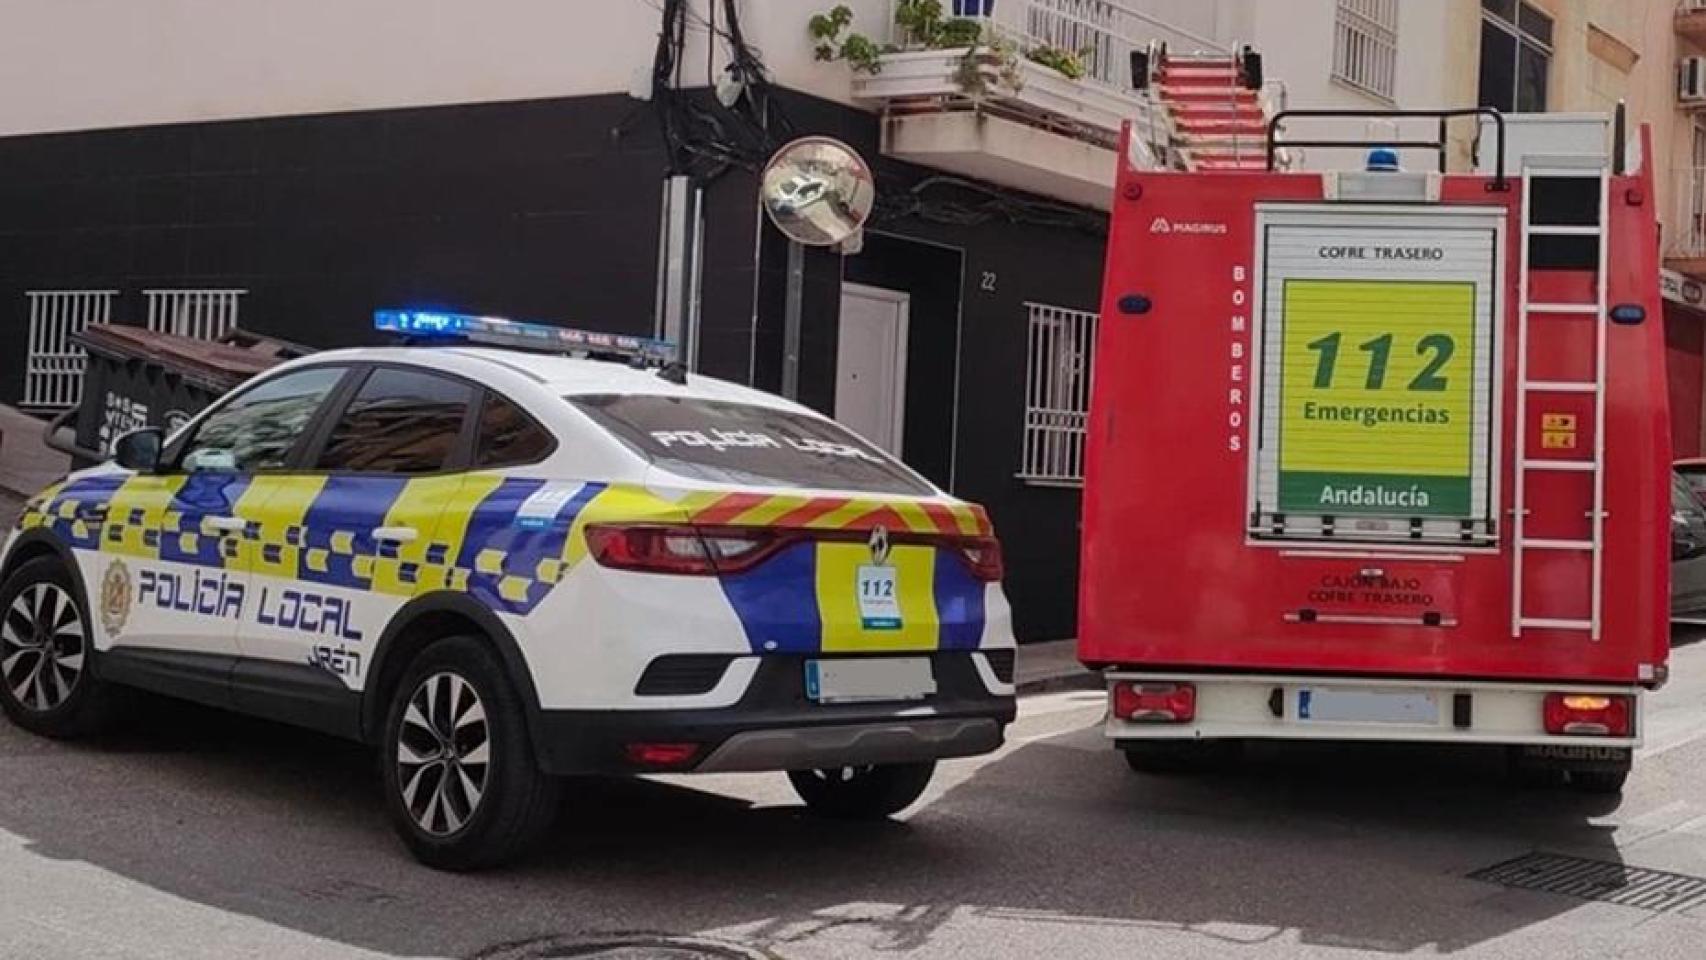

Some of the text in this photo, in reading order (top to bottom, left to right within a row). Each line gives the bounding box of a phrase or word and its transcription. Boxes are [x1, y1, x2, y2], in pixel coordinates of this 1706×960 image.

[1172, 222, 1228, 235] MAGIRUS
[1318, 245, 1444, 261] COFRE TRASERO
[981, 271, 997, 291] 22
[1229, 265, 1245, 451] BOMBEROS
[1307, 331, 1456, 392] 112
[1303, 401, 1450, 427] Emergencias
[1319, 484, 1431, 507] Andalucía
[861, 579, 894, 597] 112
[1308, 590, 1434, 606] COFRE TRASERO
[257, 586, 363, 641] LOCAL
